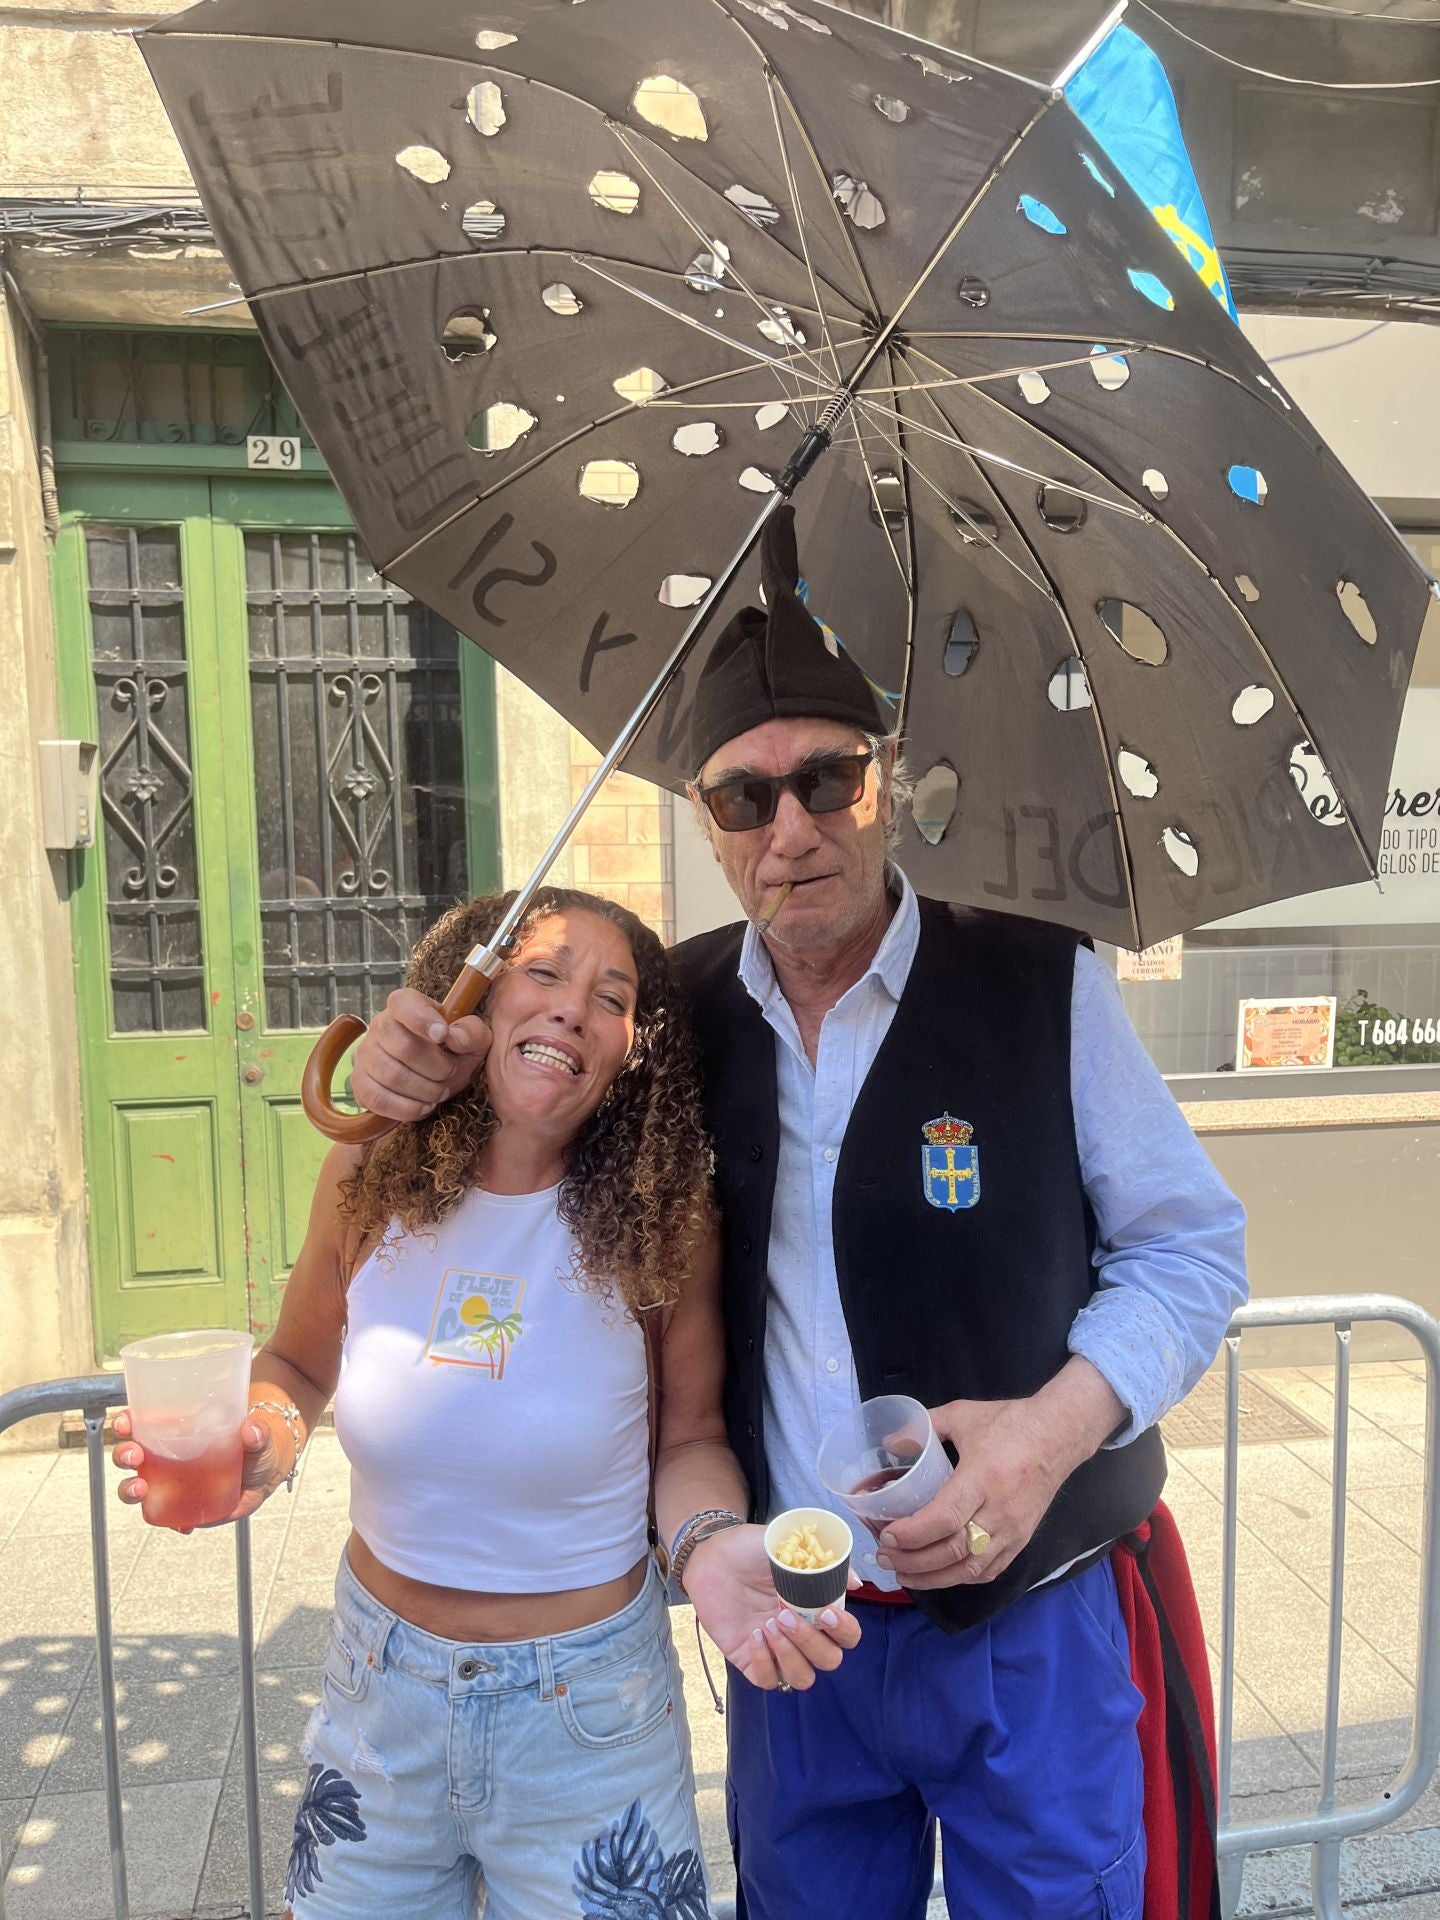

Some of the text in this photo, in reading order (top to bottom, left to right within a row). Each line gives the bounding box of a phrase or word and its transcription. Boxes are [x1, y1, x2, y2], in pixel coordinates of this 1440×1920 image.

[252, 439, 296, 467] 29
[1382, 828, 1438, 851] DO TIPO
[1379, 853, 1416, 875] GLOS
[1358, 1019, 1369, 1046] T
[1372, 1018, 1408, 1046] 684
[456, 1274, 515, 1297] FLEJE
[449, 1291, 513, 1309] DE SOL
